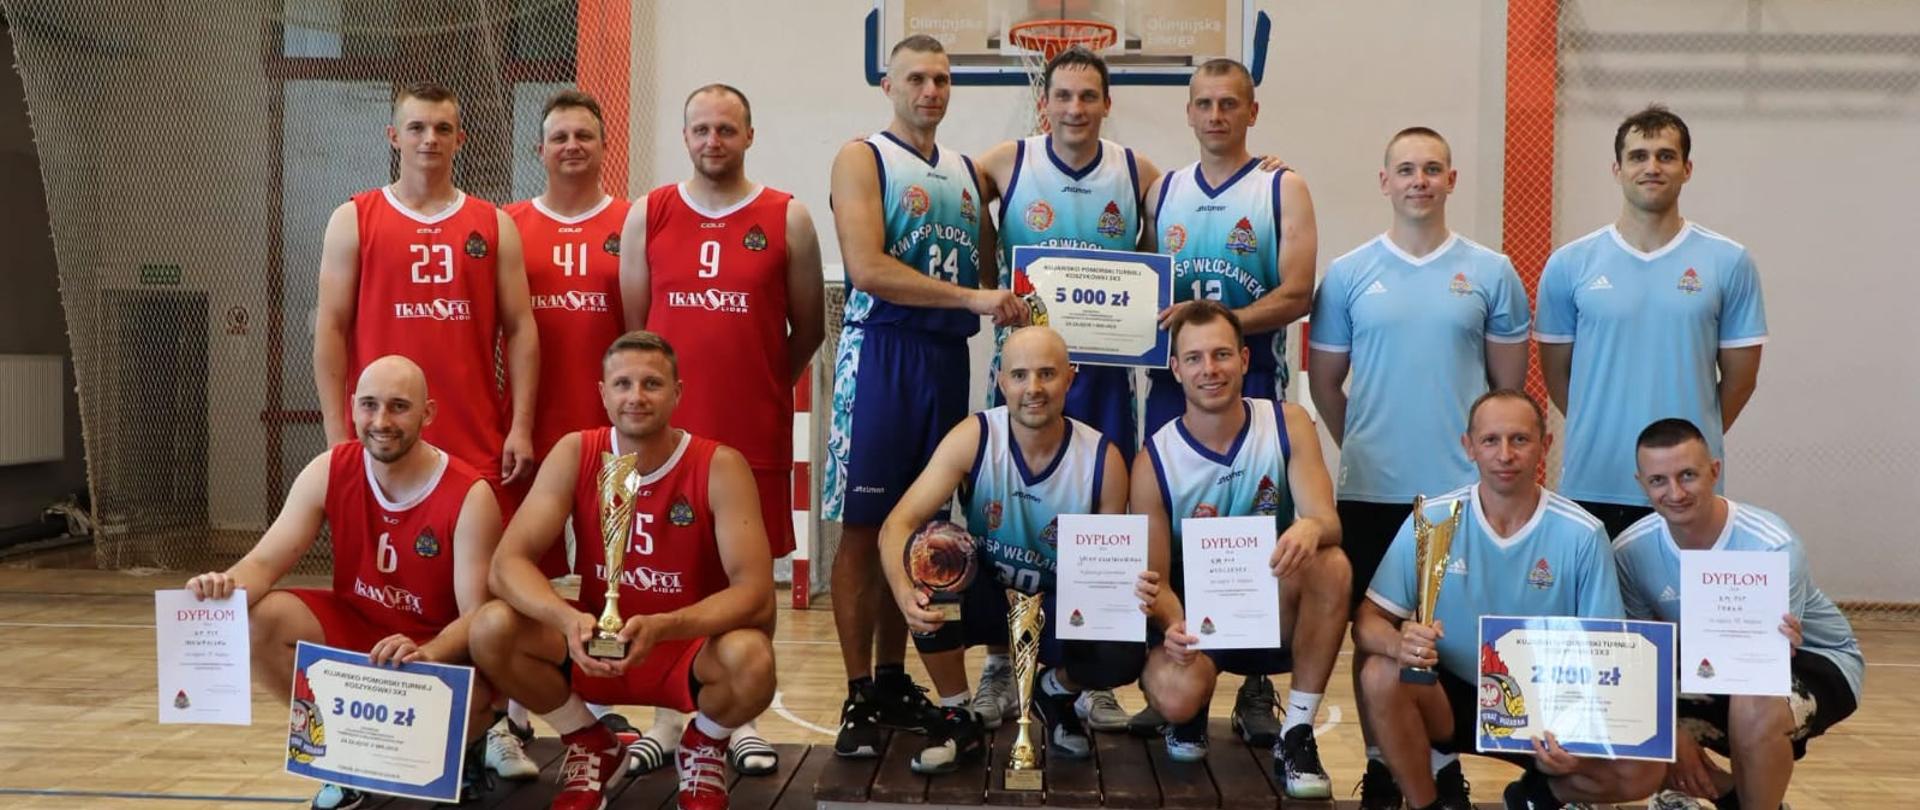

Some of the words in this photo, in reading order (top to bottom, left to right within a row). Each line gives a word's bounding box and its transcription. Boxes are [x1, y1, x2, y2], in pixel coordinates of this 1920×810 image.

[890, 236, 911, 257] KM
[910, 224, 933, 245] PSP
[409, 244, 454, 284] 23
[552, 242, 587, 277] 41
[698, 240, 721, 278] 9
[928, 243, 959, 284] 24
[1175, 260, 1190, 277] SP
[1193, 258, 1266, 300] WŁOCŁAWEK
[1191, 279, 1222, 300] 12
[394, 298, 470, 320] TRANSPO
[1055, 287, 1066, 303] 5
[1072, 288, 1106, 305] 000
[1111, 291, 1130, 306] zł
[376, 532, 398, 573] 6
[1076, 534, 1131, 546] DYPLOM
[1201, 536, 1258, 550] DYPLOM
[994, 561, 1040, 593] 30
[1702, 572, 1768, 586] DYPLOM
[177, 609, 235, 621] DYPLOM
[1531, 666, 1544, 683] 2
[1598, 666, 1621, 686] zł
[332, 697, 345, 715] 3
[351, 700, 388, 723] 000
[393, 707, 416, 727] zł
